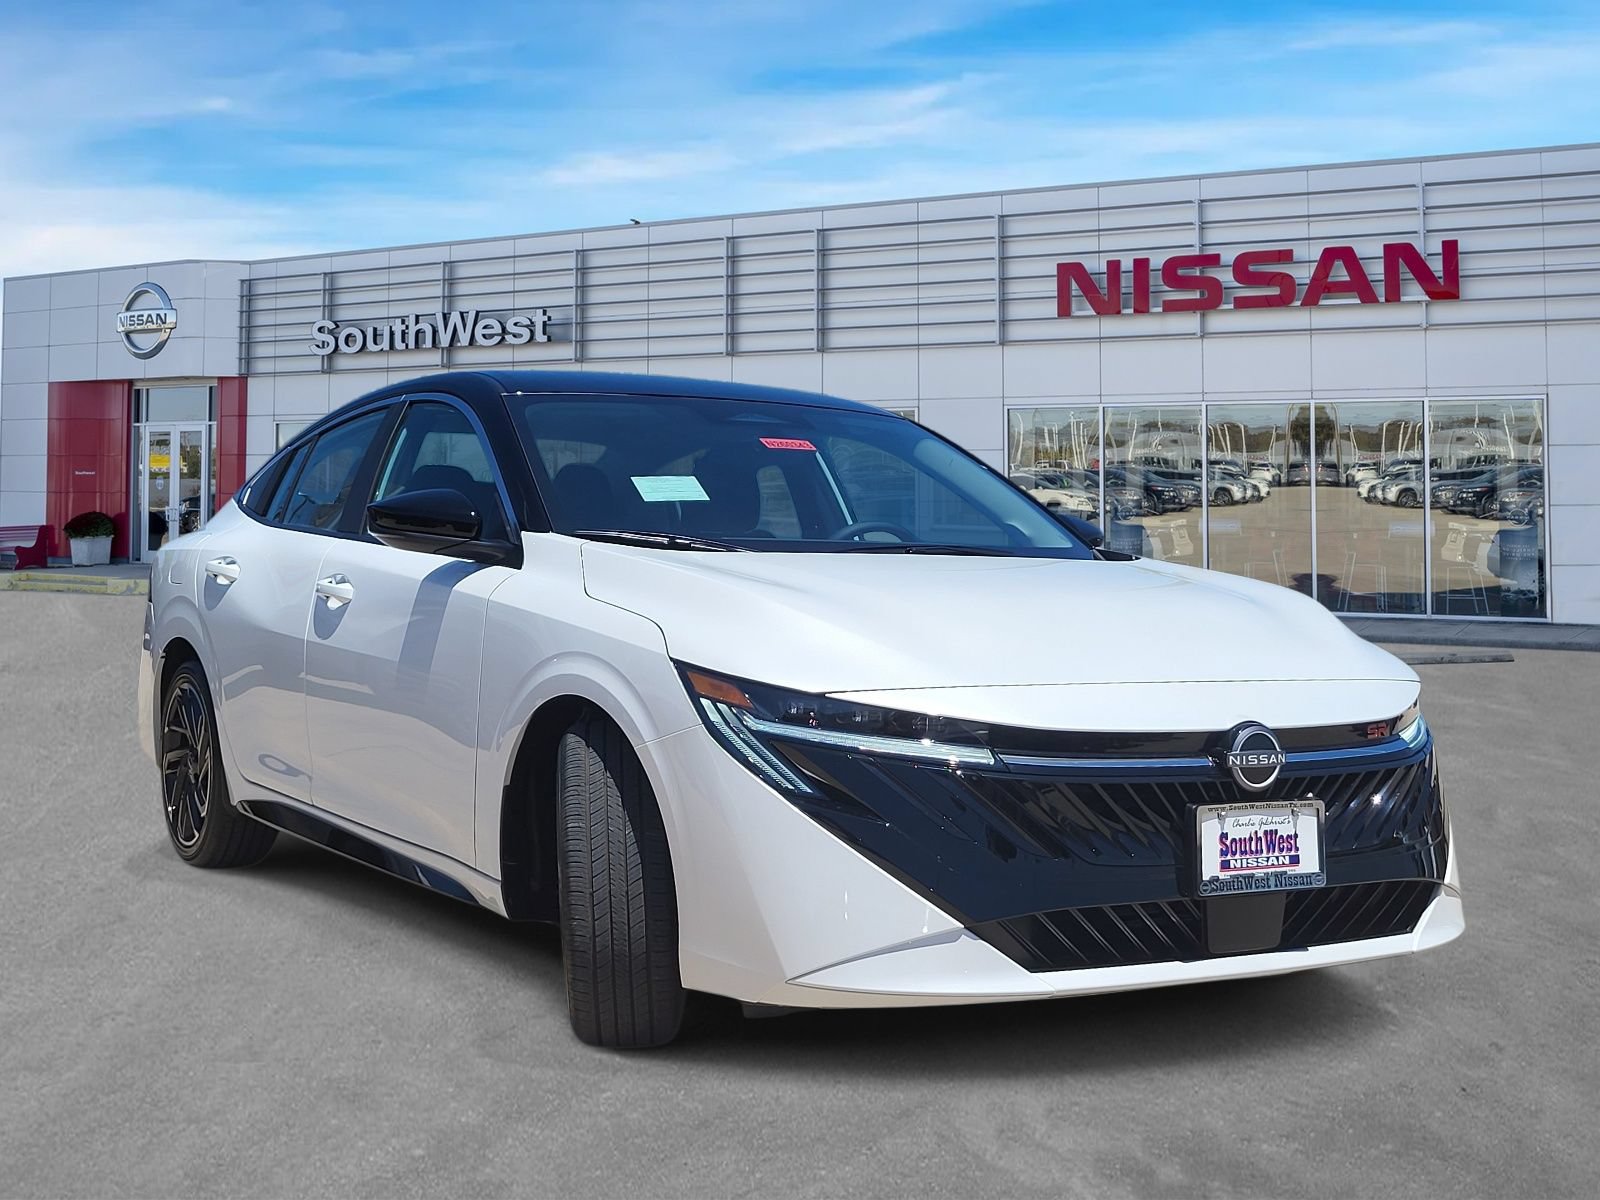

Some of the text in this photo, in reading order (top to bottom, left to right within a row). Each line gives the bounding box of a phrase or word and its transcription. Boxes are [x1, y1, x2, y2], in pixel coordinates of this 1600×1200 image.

[1056, 239, 1461, 318] NISSAN
[119, 313, 167, 328] NISSAN
[309, 308, 551, 356] SouthWest
[1367, 723, 1389, 739] SR
[1228, 753, 1286, 765] NISSAN
[1219, 829, 1299, 858] SouthWest
[1230, 855, 1290, 868] NISSAN
[1211, 874, 1271, 892] SouthWest
[1274, 873, 1313, 887] Nissan
